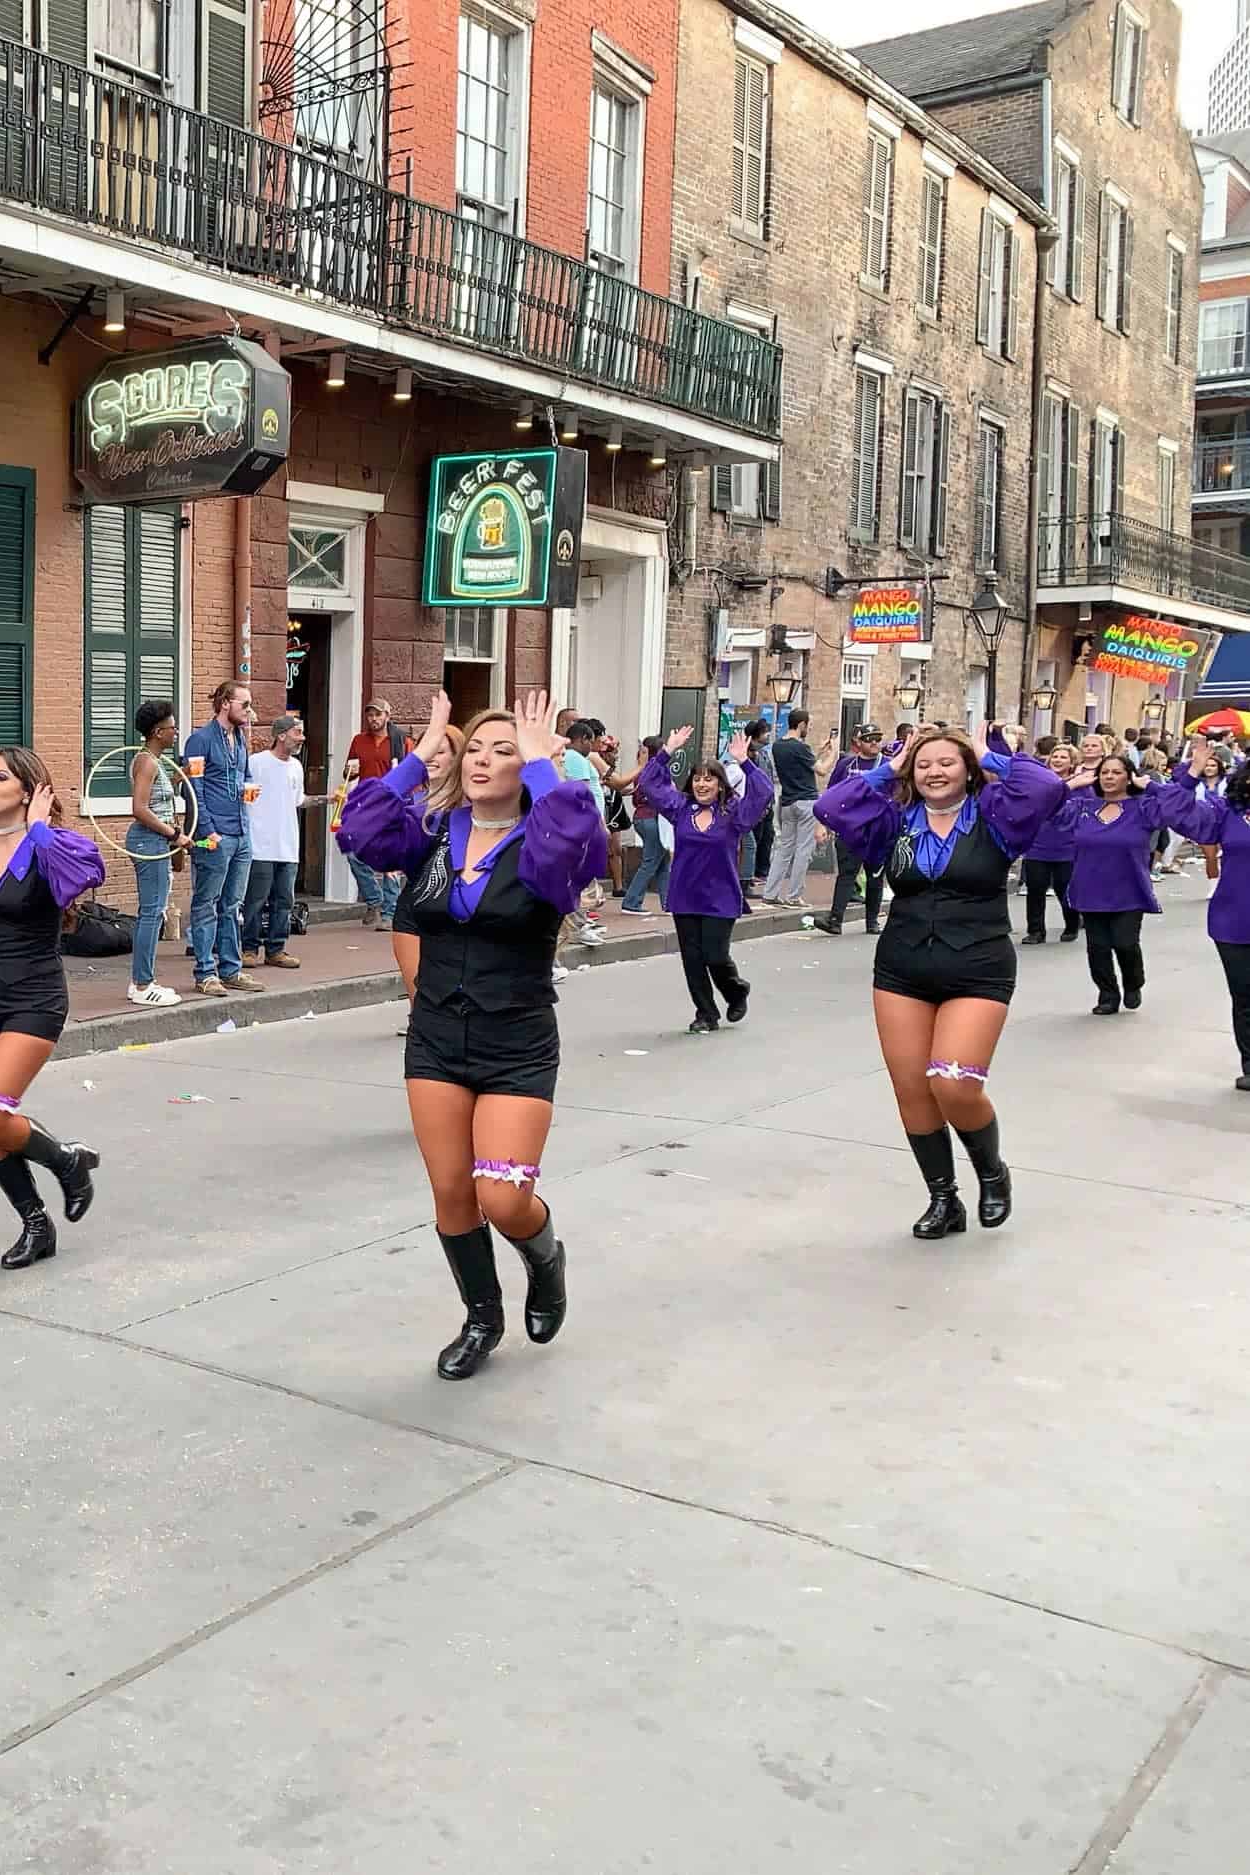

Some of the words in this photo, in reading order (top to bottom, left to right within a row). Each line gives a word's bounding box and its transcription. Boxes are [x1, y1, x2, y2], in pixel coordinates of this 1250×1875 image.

[88, 359, 249, 451] SCORES
[157, 425, 245, 467] Orleans
[503, 459, 552, 526] FEST
[854, 601, 919, 617] MANGO
[862, 590, 910, 602] MANGO
[854, 615, 917, 627] DAIQUIRIS
[1127, 616, 1183, 636] MANGO
[1103, 623, 1199, 657] MANGO
[1107, 641, 1187, 669] DAIQUIRIS
